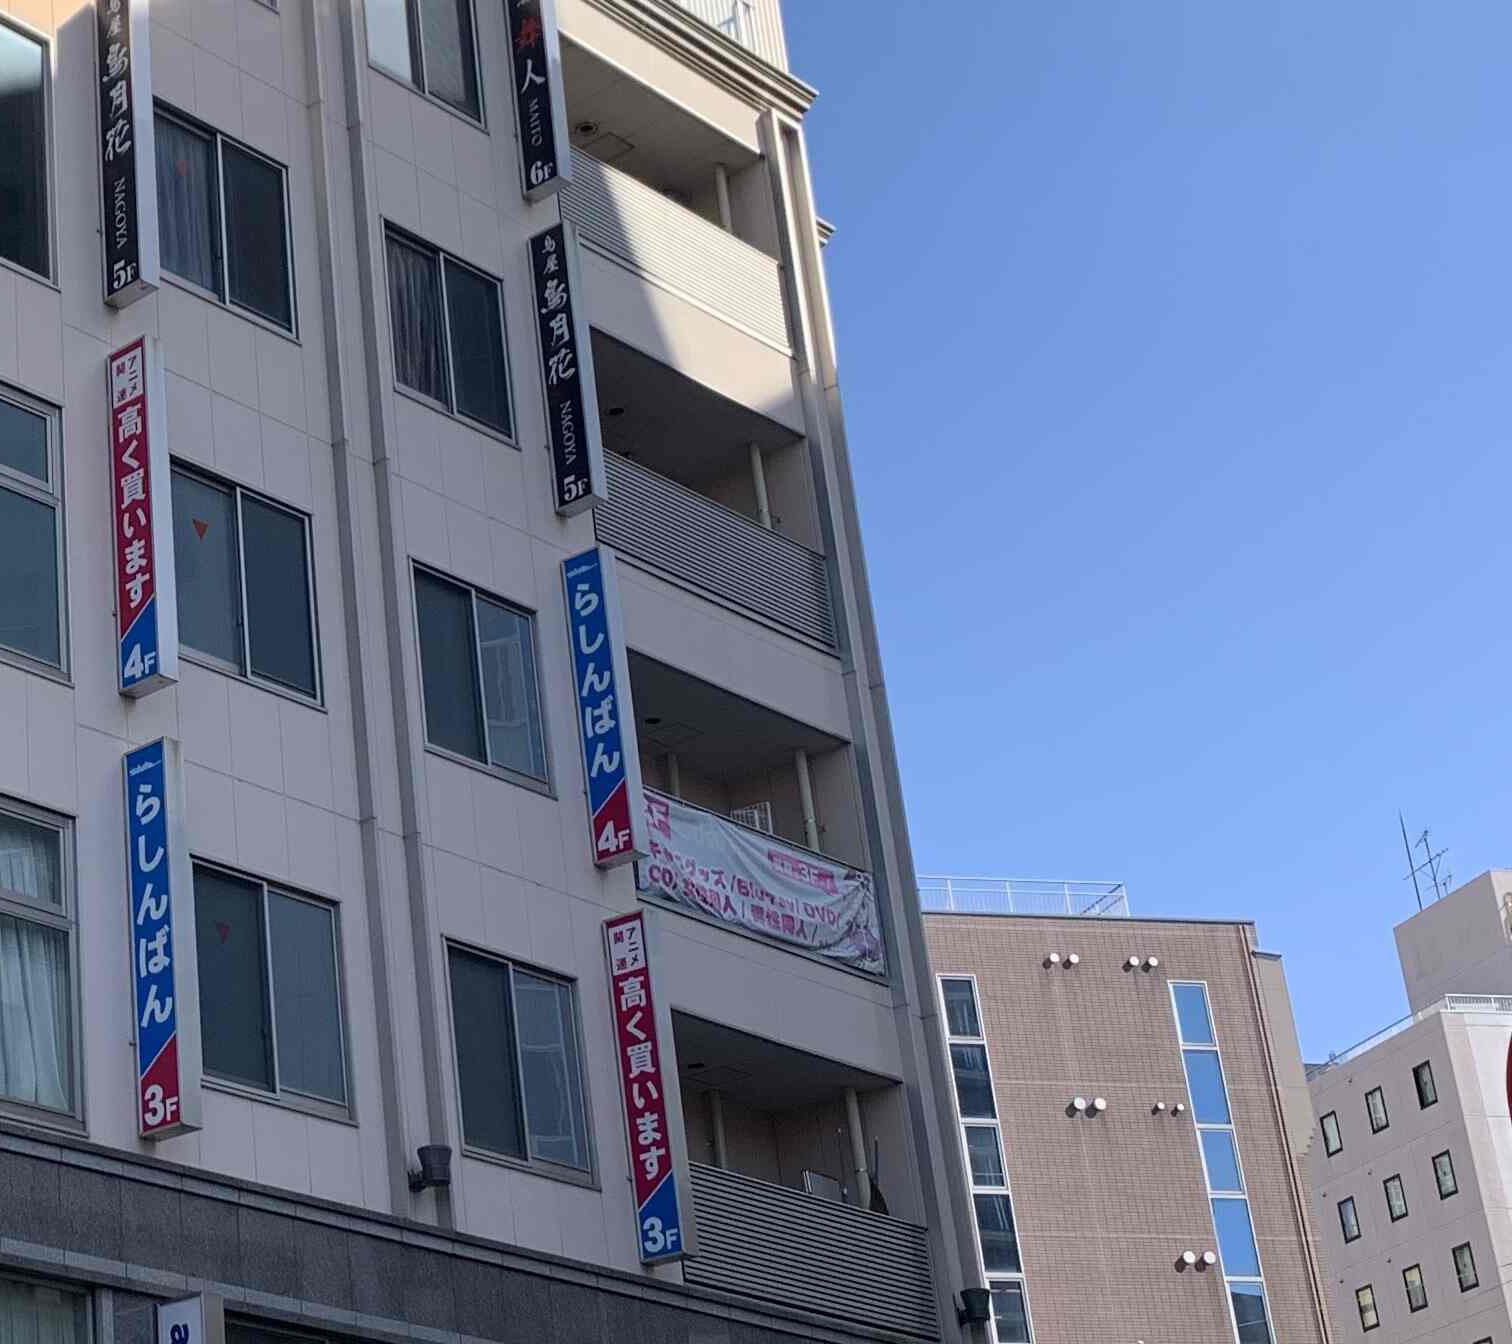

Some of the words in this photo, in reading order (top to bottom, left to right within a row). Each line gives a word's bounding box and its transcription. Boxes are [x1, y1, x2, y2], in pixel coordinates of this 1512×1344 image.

[113, 177, 128, 249] NAGOYA
[113, 259, 138, 290] 5F
[127, 357, 140, 396] アニメ
[559, 399, 577, 466] NAGOYA
[117, 404, 150, 609] 高く買います
[563, 474, 589, 502] 5F
[123, 643, 157, 679] 4F
[574, 583, 620, 778] らしんばん
[597, 820, 631, 854] 4F
[135, 783, 172, 1029] らしんばん
[624, 927, 640, 967] アニメ
[618, 976, 666, 1181] 高く買います
[143, 1084, 179, 1127] 3F
[642, 1216, 679, 1254] 3F
